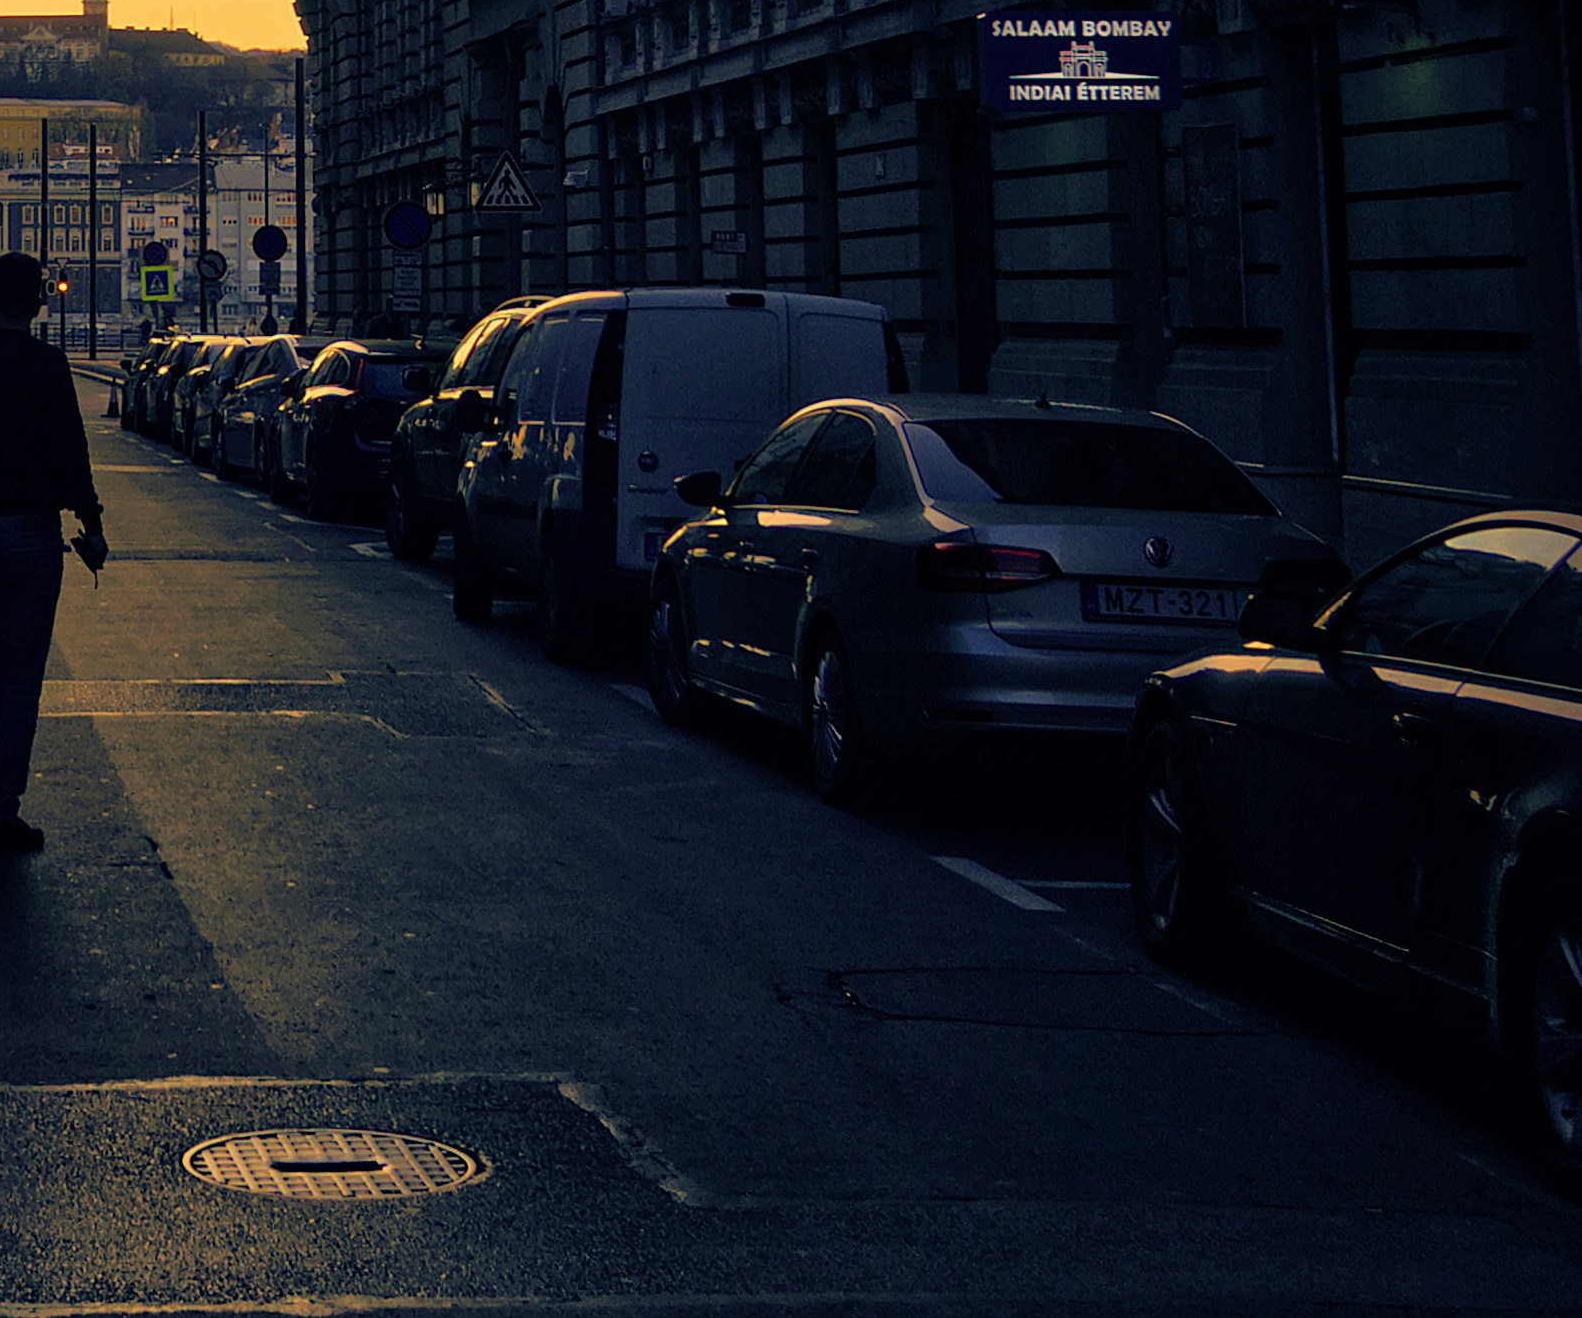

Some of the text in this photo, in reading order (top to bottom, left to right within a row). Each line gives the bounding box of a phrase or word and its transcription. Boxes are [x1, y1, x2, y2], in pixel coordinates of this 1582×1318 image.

[991, 19, 1173, 38] SALAAM BOMBAY
[1008, 81, 1161, 101] INDIAI ÉTTEREM
[1104, 587, 1227, 617] MZT-321
